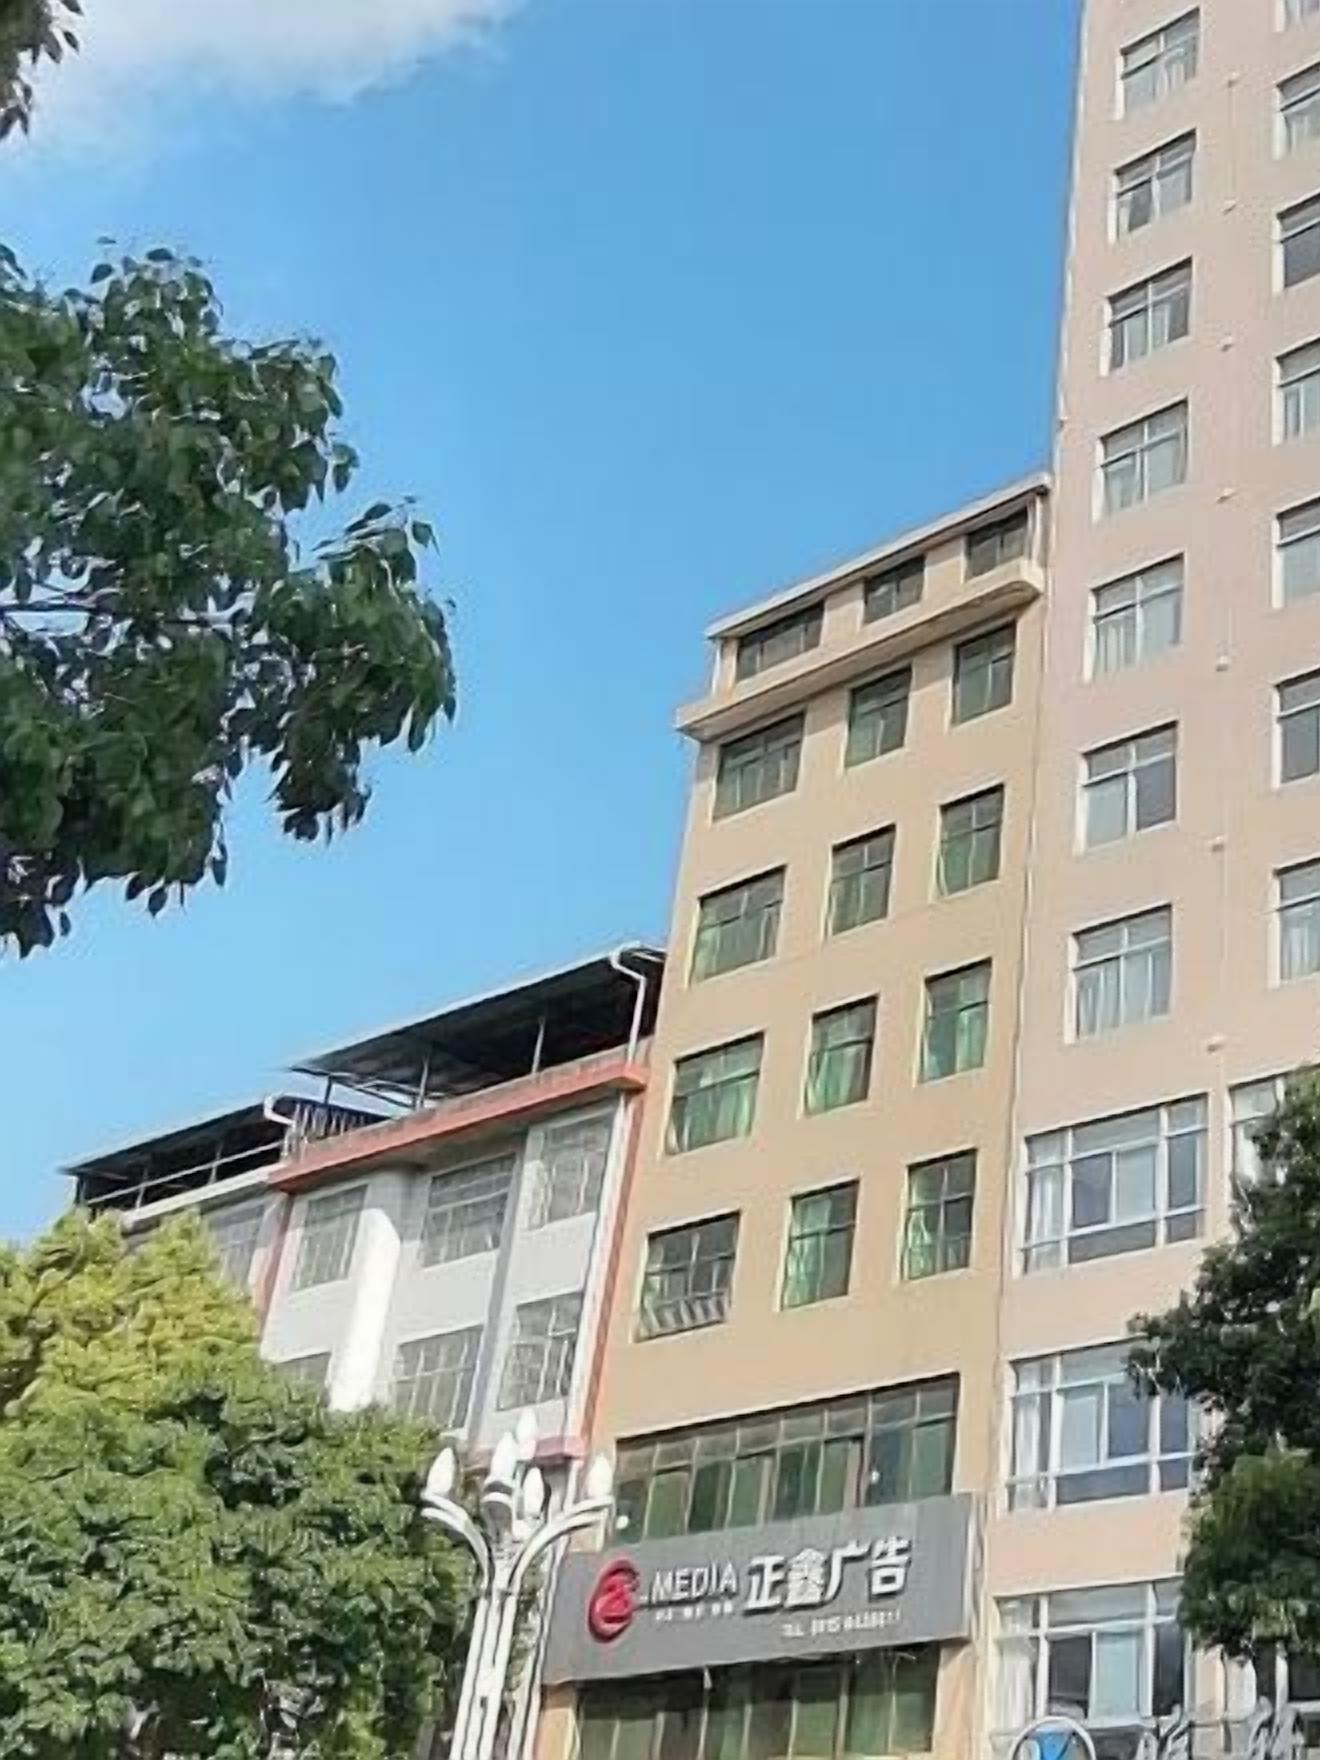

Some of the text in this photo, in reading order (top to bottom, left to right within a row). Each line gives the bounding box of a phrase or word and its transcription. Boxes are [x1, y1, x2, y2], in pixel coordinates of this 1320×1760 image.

[651, 1560, 737, 1602] MEDIA
[745, 1536, 911, 1609] 正鑫广告
